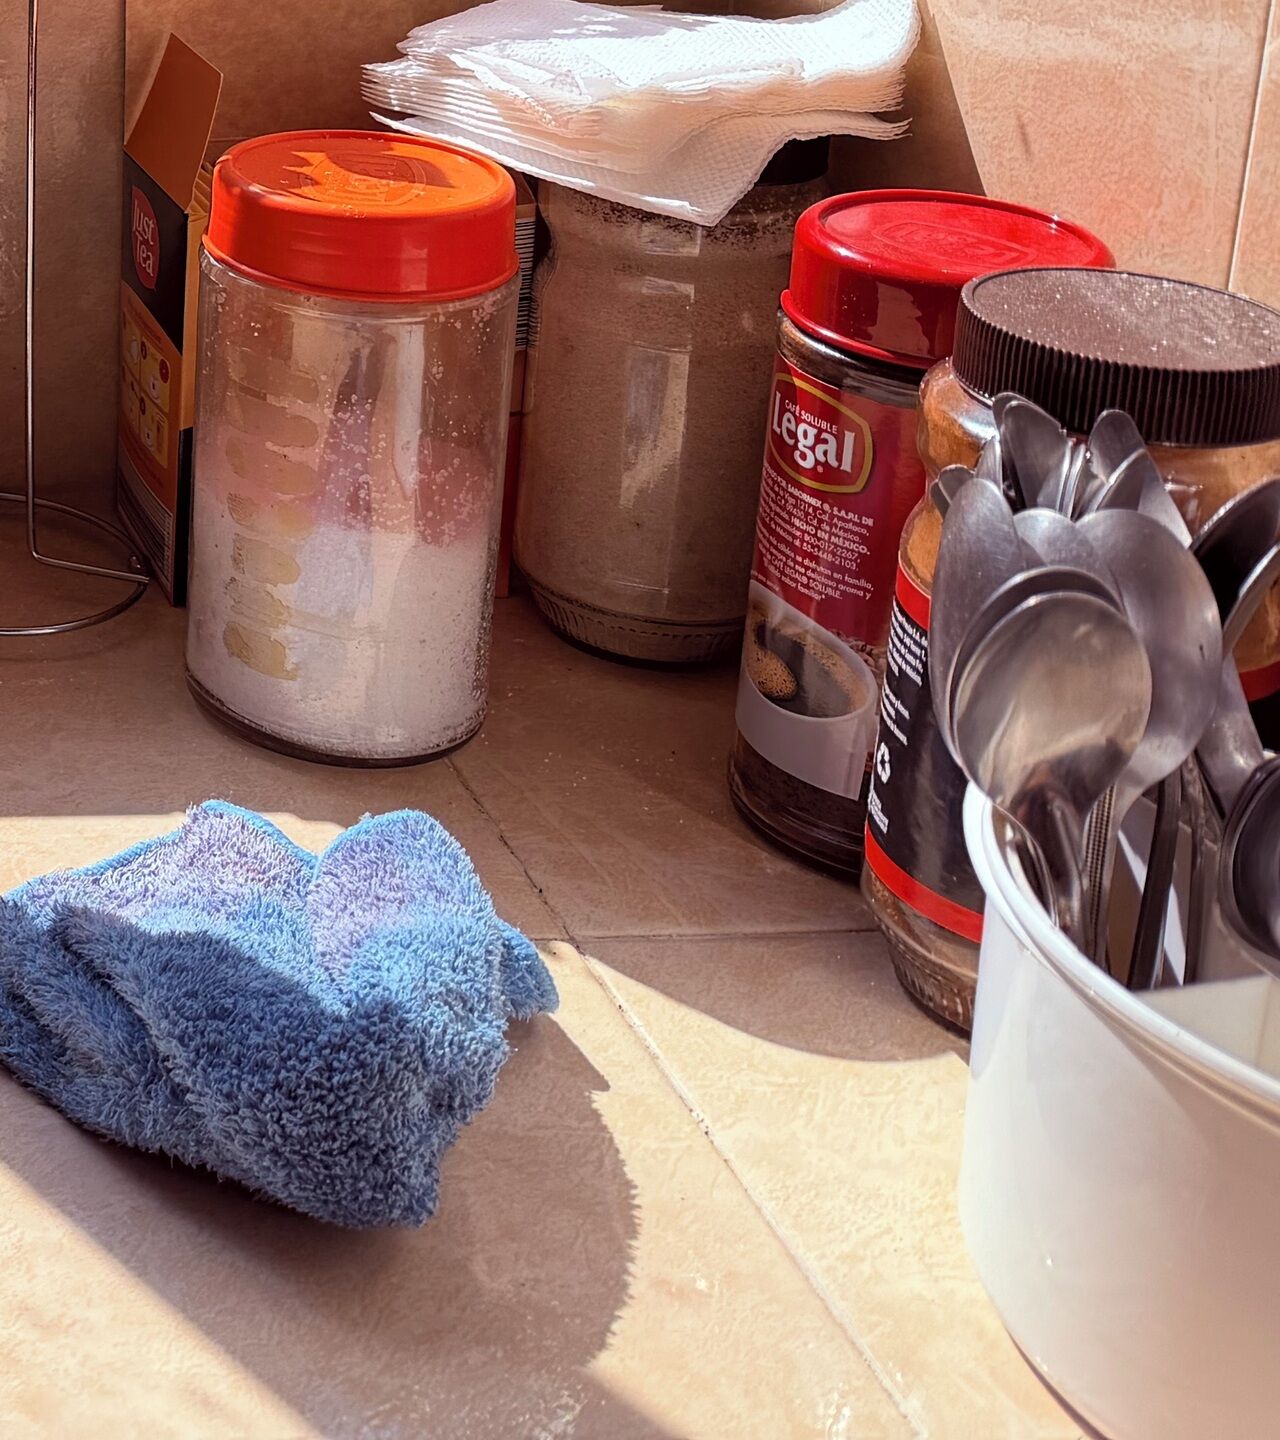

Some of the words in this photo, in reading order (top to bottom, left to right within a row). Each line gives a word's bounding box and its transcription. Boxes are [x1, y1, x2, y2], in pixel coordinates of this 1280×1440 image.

[772, 390, 856, 473] Legal
[800, 409, 839, 435] SOLUBLE
[817, 529, 830, 542] EN
